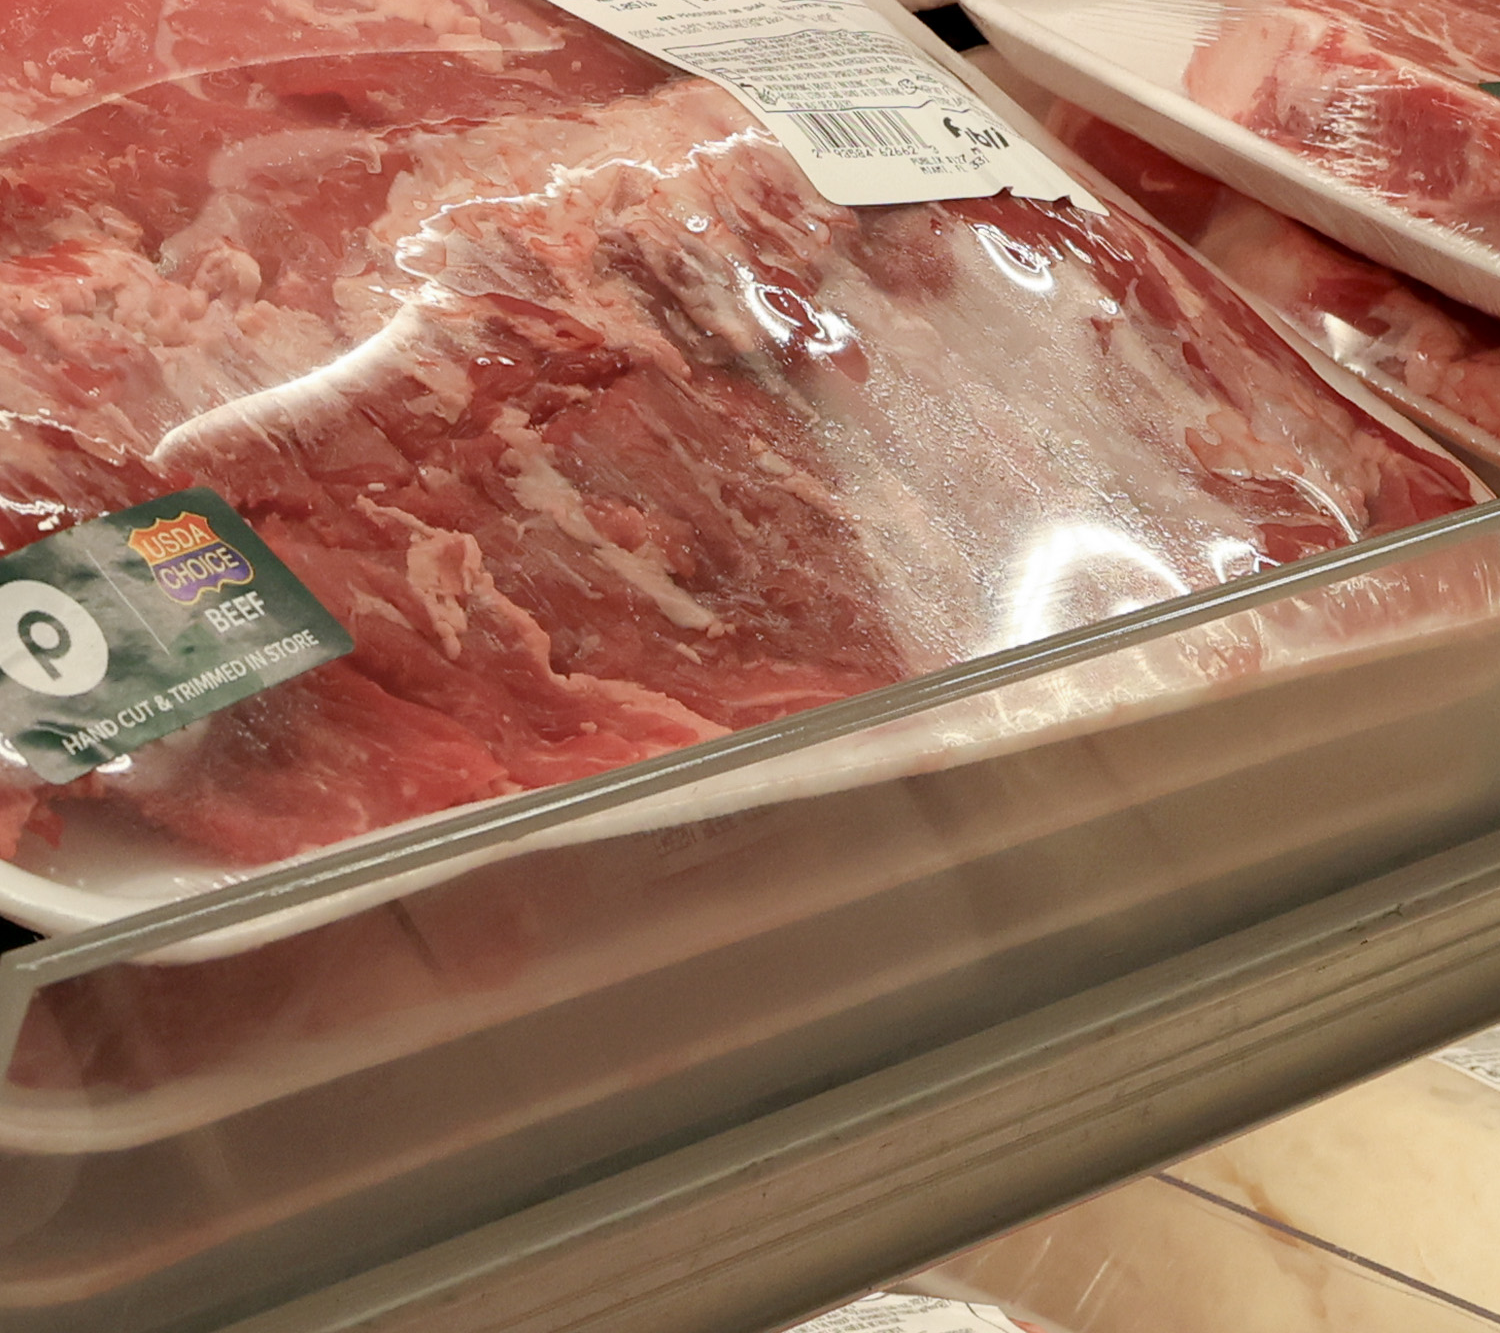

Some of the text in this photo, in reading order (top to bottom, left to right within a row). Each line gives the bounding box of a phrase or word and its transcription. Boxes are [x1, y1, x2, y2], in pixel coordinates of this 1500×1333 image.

[878, 147, 918, 157] 62662
[146, 521, 208, 562] USDA
[158, 543, 241, 592] CHOICE
[205, 590, 268, 634] BEEF
[62, 629, 320, 756] HAND CUT & TRIMMED IN STORE
